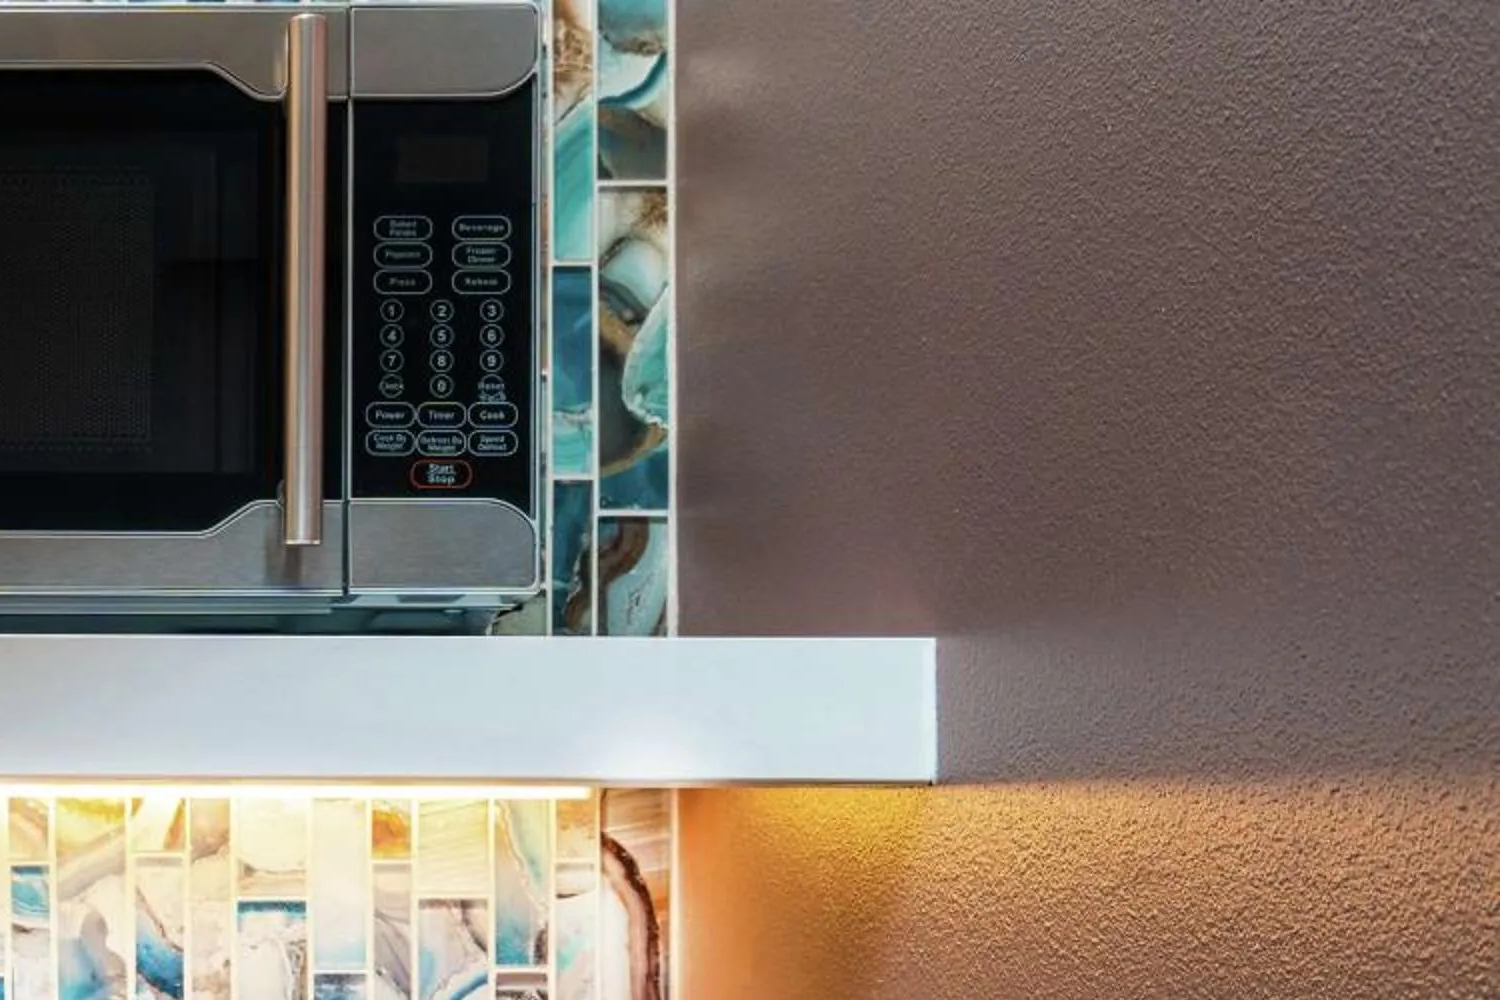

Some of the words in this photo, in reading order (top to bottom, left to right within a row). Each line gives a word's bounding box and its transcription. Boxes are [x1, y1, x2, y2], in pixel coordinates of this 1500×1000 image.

[387, 305, 397, 317] 1
[436, 305, 447, 317] 2
[486, 305, 497, 317] 3
[387, 329, 397, 342] 4
[436, 329, 447, 342] 5
[486, 329, 497, 342] 6
[387, 354, 397, 367] 7
[436, 354, 447, 367] 8
[486, 354, 497, 367] 9
[436, 379, 447, 393] 0
[375, 410, 405, 420] Power
[428, 410, 455, 420] Timer
[480, 410, 505, 420] Cook
[427, 474, 456, 487] Stop
